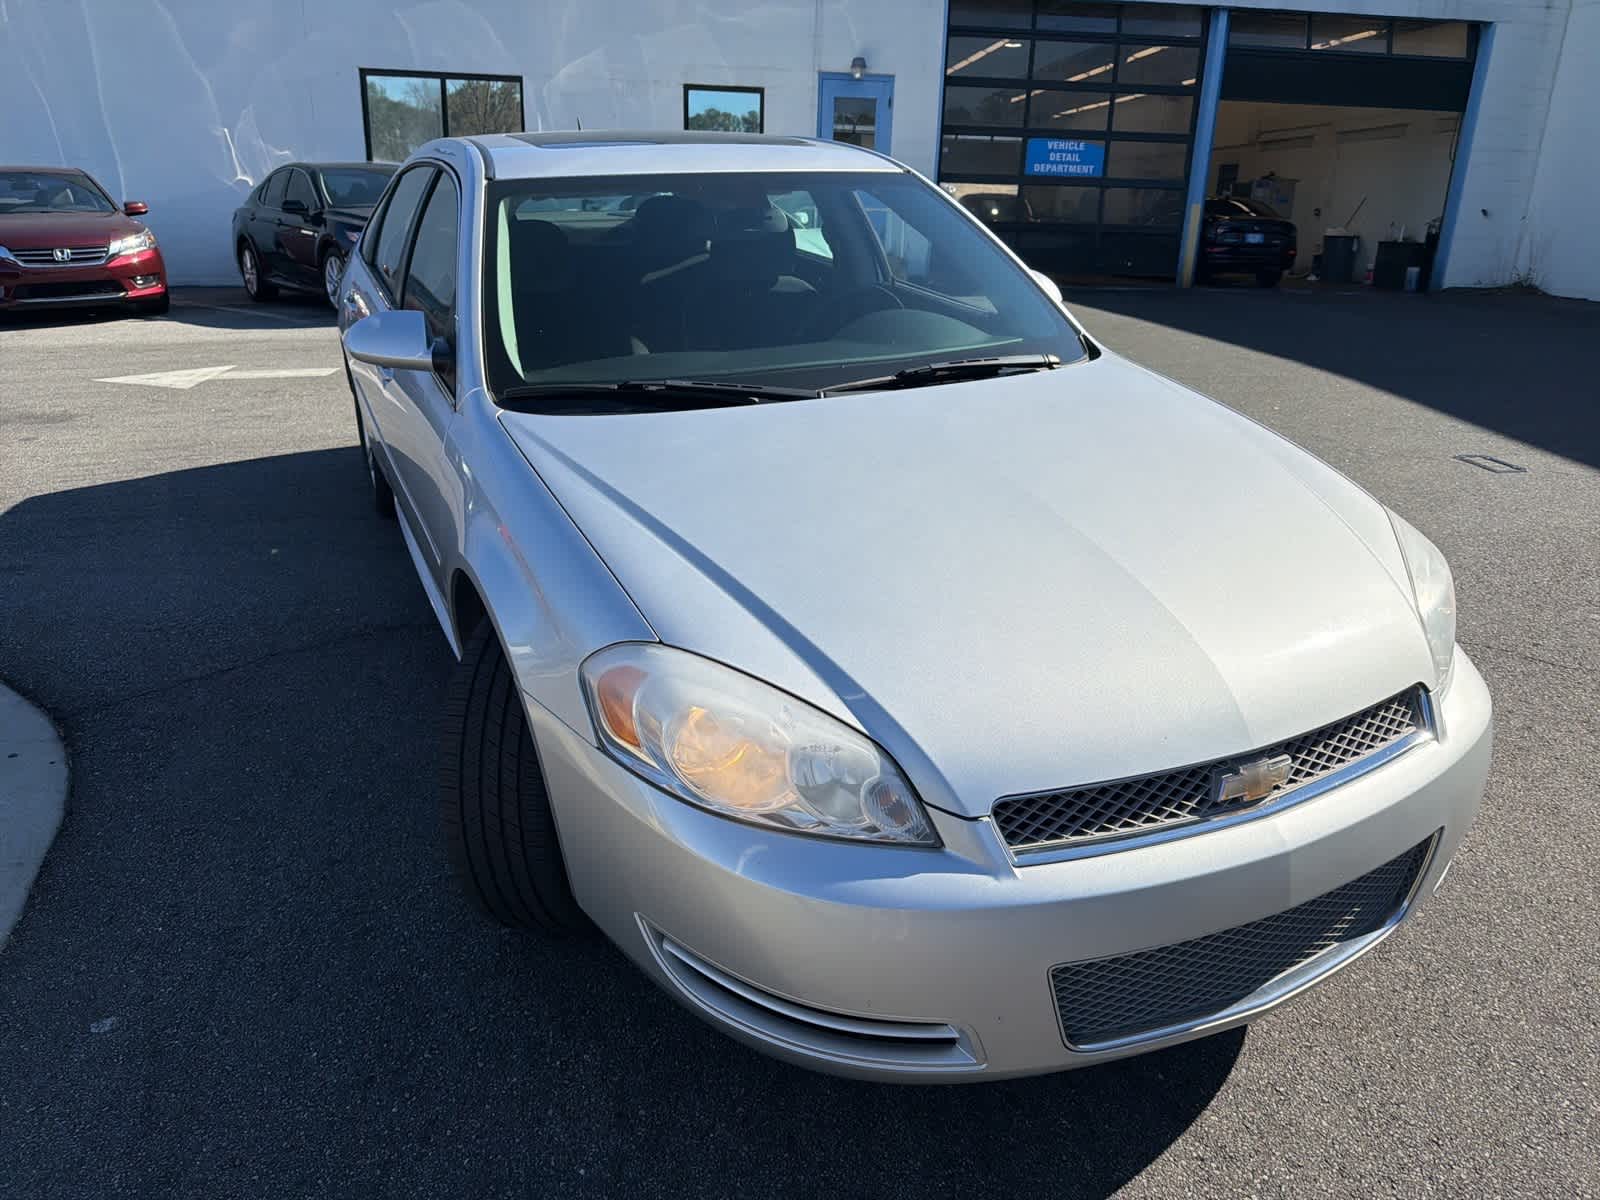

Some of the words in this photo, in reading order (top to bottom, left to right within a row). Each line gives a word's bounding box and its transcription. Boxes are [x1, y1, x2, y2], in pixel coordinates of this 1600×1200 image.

[1047, 140, 1086, 151] VEHICLE
[1049, 152, 1081, 162] DETAIL
[1033, 163, 1095, 174] DEPARTMENT
